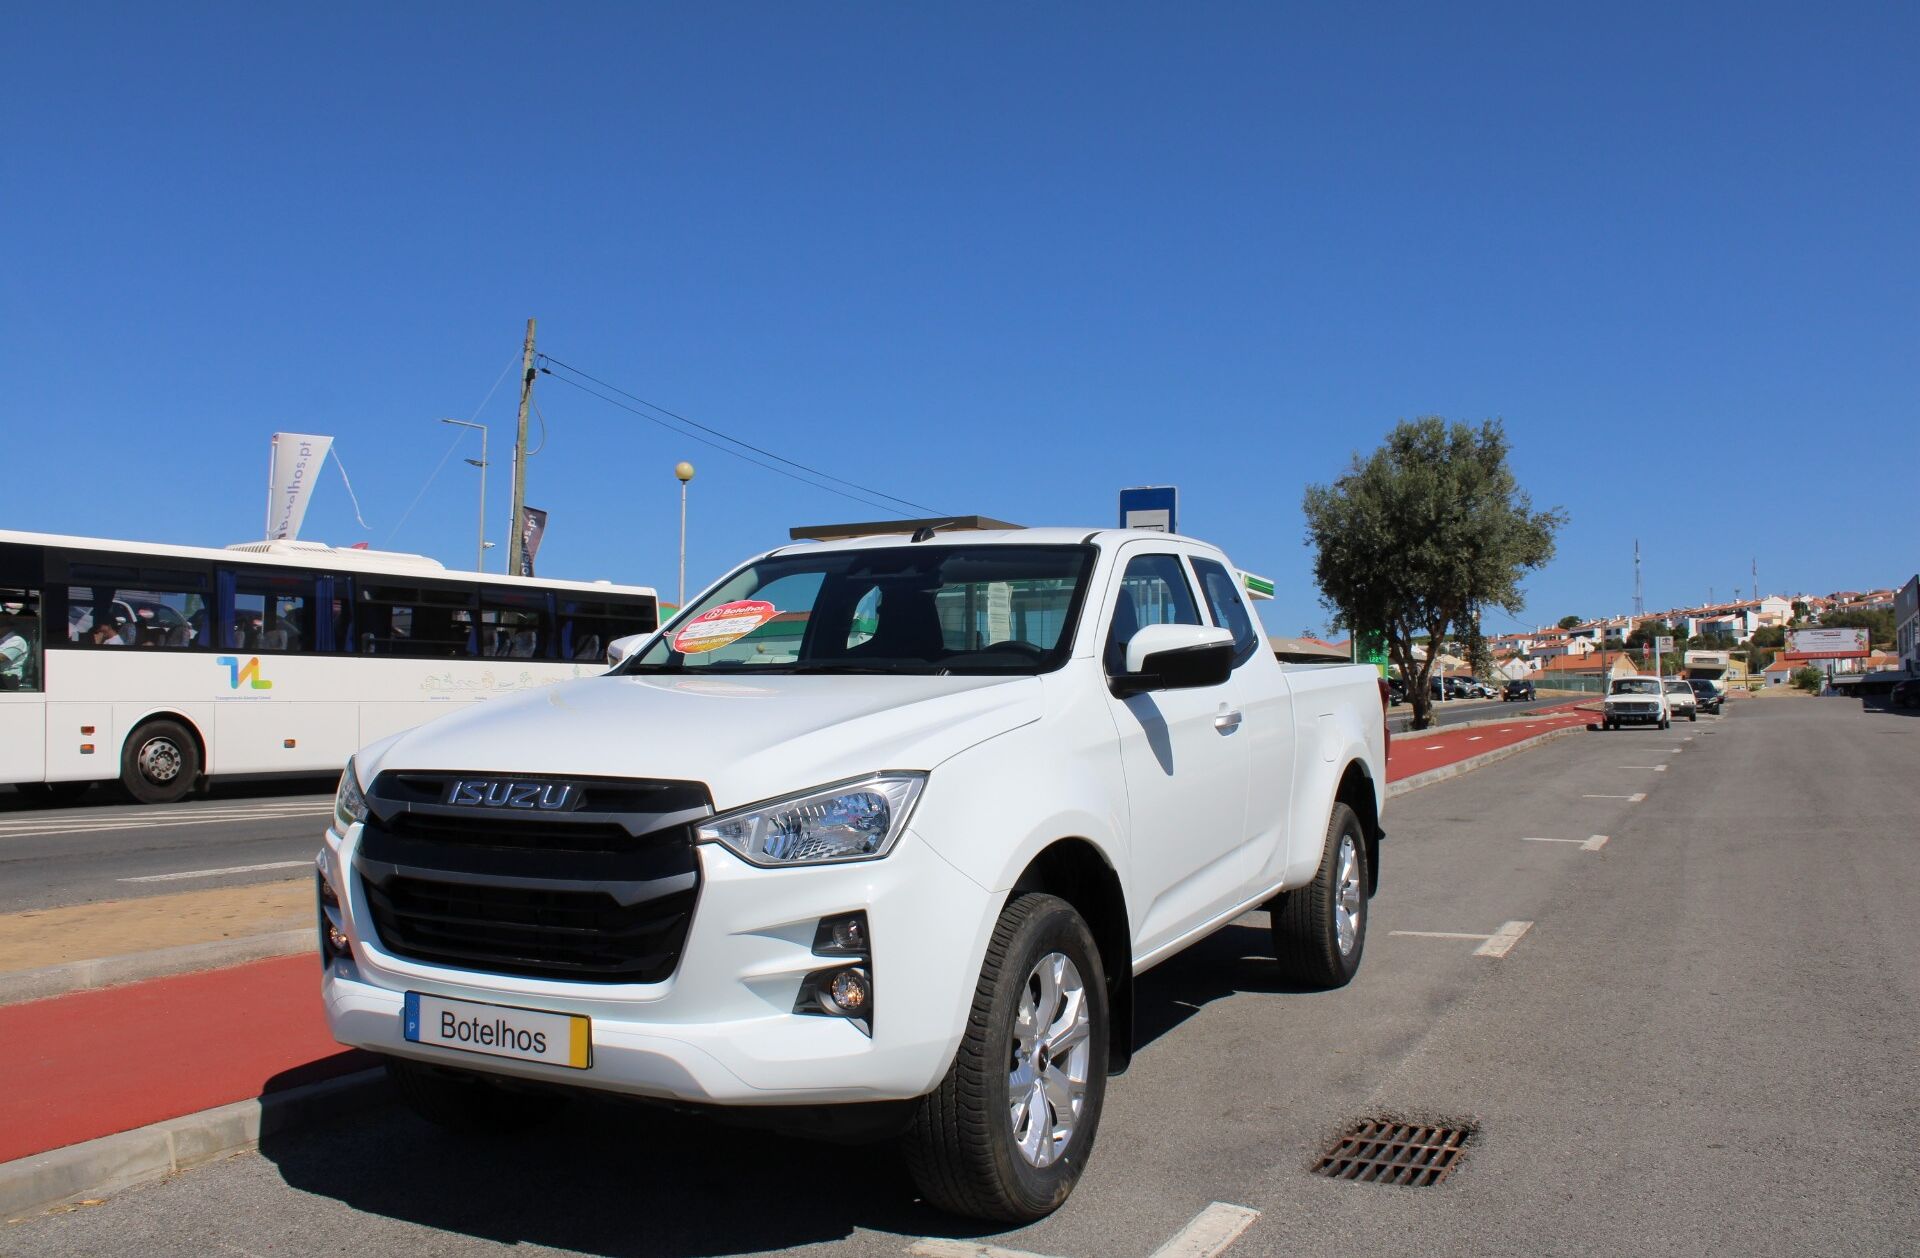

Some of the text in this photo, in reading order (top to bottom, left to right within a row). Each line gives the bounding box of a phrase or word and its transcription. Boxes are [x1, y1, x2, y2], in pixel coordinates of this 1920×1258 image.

[723, 605, 765, 615] Botelhos
[448, 780, 571, 809] ISUZU
[409, 1022, 416, 1032] P
[441, 1010, 547, 1054] Botelhos
